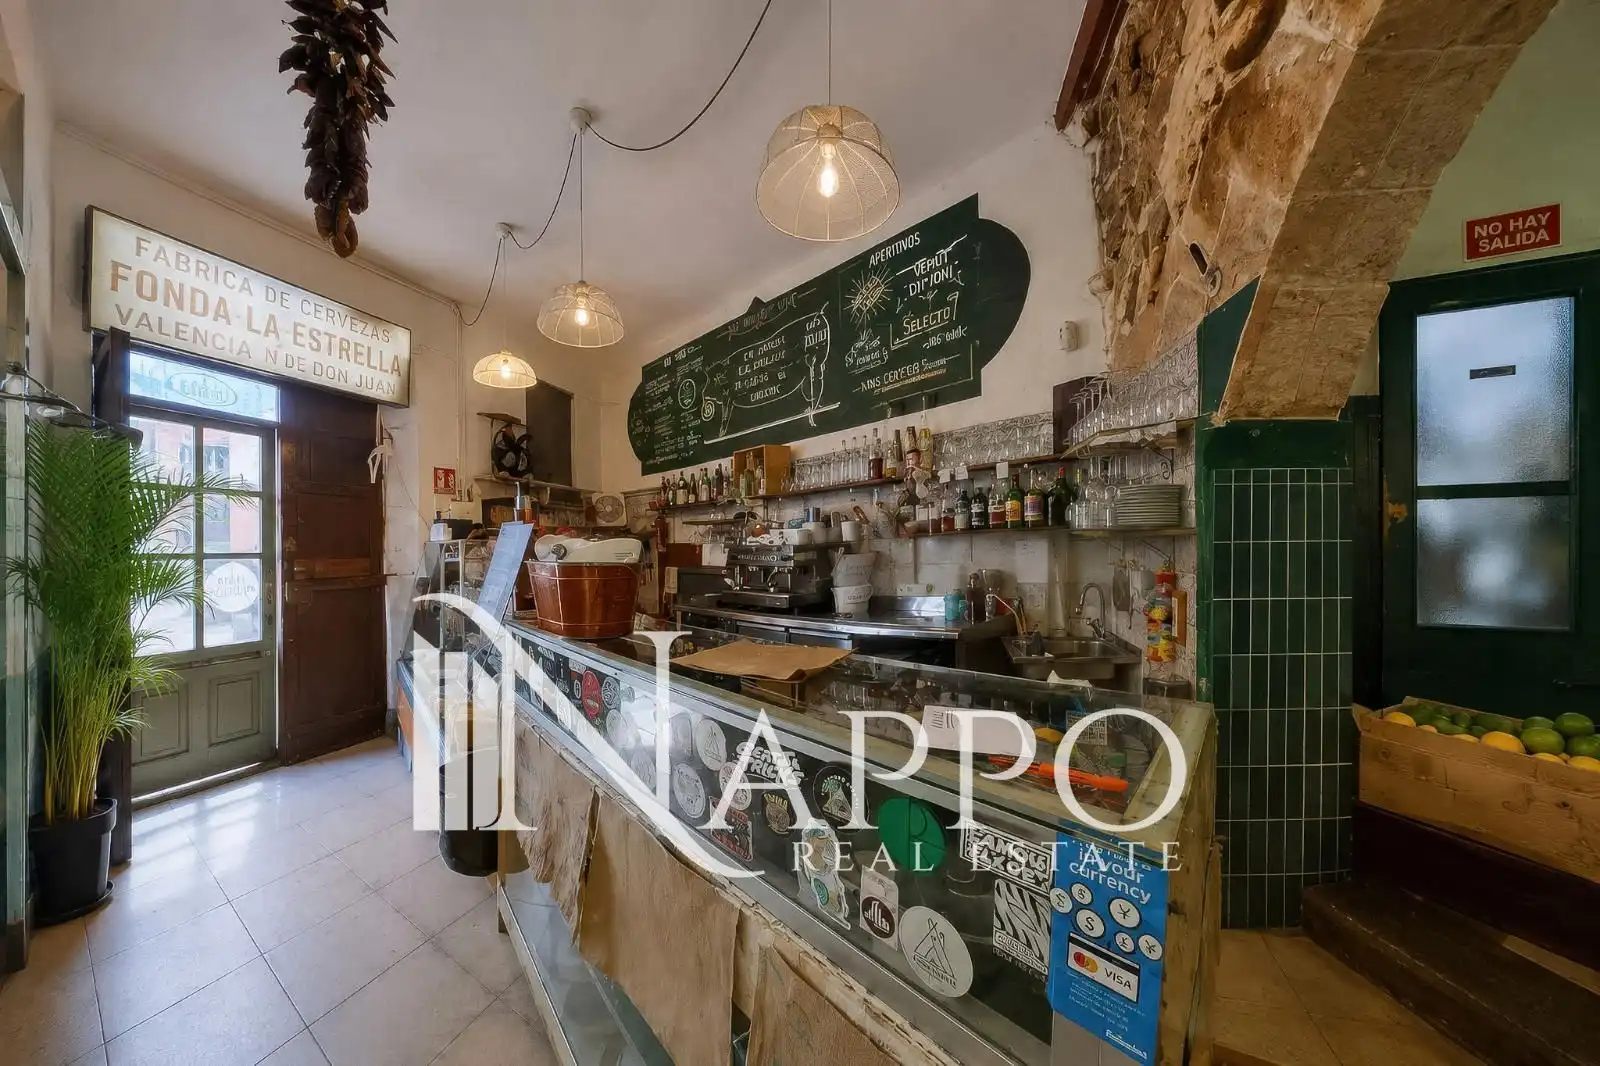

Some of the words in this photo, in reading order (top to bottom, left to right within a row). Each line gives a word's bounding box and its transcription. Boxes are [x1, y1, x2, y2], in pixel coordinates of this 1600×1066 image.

[1474, 222, 1502, 239] NO
[1509, 211, 1552, 231] HAY
[1478, 228, 1549, 252] SALIDA
[868, 232, 921, 269] APERITIVOS
[135, 236, 254, 297] FABRICA
[265, 285, 291, 310] DE
[300, 298, 391, 344] CERVEZAS
[110, 259, 232, 326] FONDA
[246, 305, 280, 341] LA
[293, 320, 402, 377] ESTRELLA
[114, 303, 252, 360] VALENCIA
[285, 352, 307, 373] DE
[313, 361, 348, 384] DON
[355, 374, 396, 397] JUAN
[1069, 862, 1152, 905] currency
[1104, 967, 1133, 991] VISA
